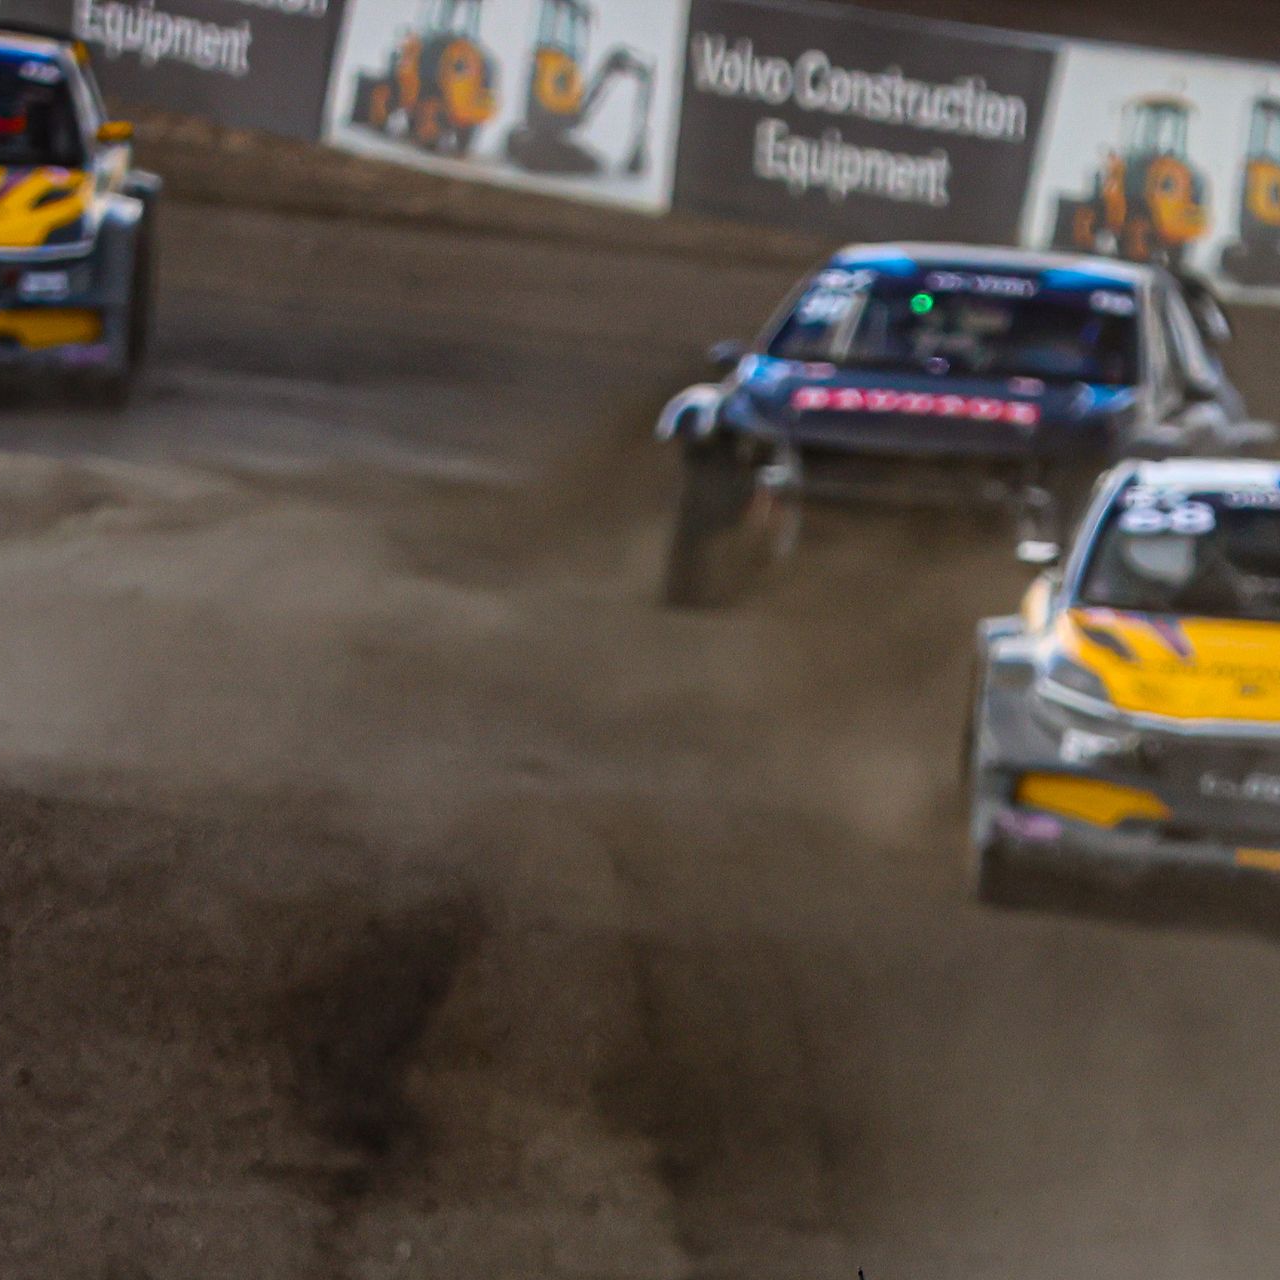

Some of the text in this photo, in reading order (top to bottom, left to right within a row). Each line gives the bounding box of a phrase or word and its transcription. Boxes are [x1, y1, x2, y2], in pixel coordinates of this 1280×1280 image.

[691, 31, 1027, 144] Volvo Construction
[753, 116, 952, 209] Equipment
